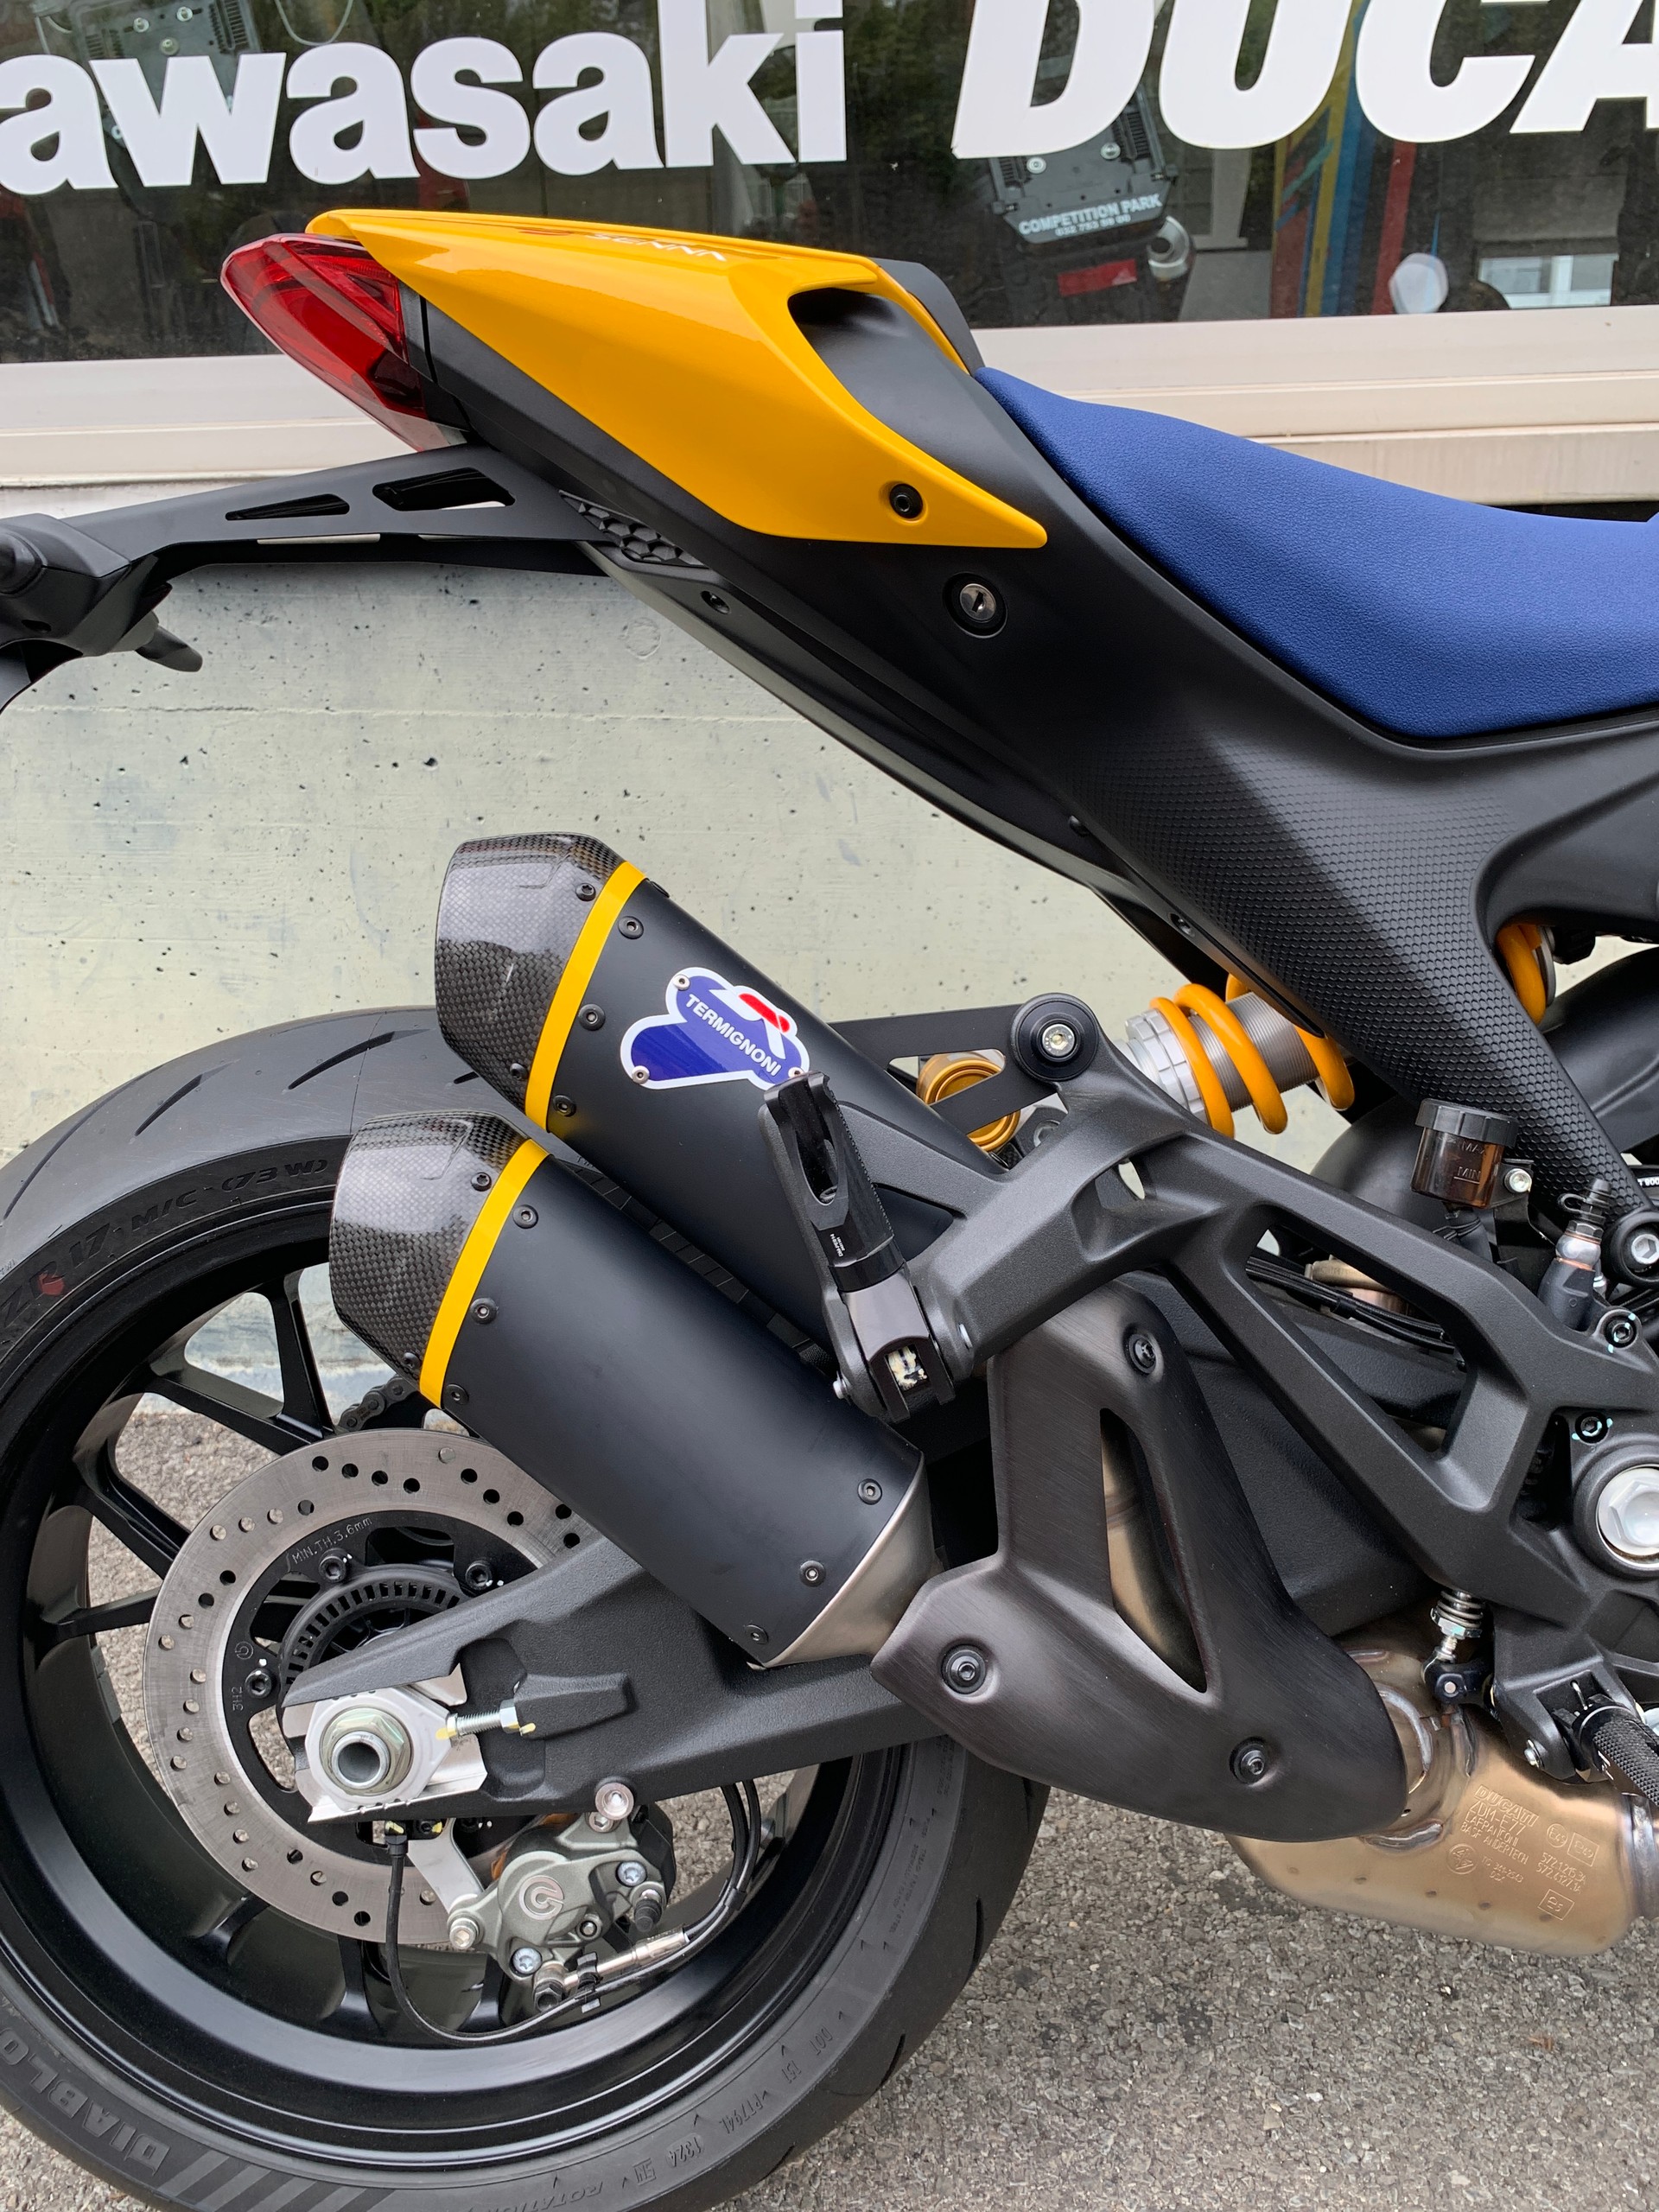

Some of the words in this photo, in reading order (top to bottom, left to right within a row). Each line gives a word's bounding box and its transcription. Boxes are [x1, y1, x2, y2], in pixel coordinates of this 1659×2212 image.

[0, 0, 846, 195] awasaki
[1019, 202, 1120, 235] COMPETITION
[1121, 193, 1163, 213] PARK
[586, 233, 727, 262] SENNA
[685, 994, 782, 1077] TERMIGNONI
[1457, 1166, 1482, 1179] MIN
[130, 1190, 197, 1231] M/C
[231, 1686, 244, 1712] 3H2
[1473, 1783, 1540, 1828] DUCATI
[810, 2026, 833, 2056] DOT
[0, 2027, 171, 2177] DIABLO
[669, 2135, 702, 2167] 1324
